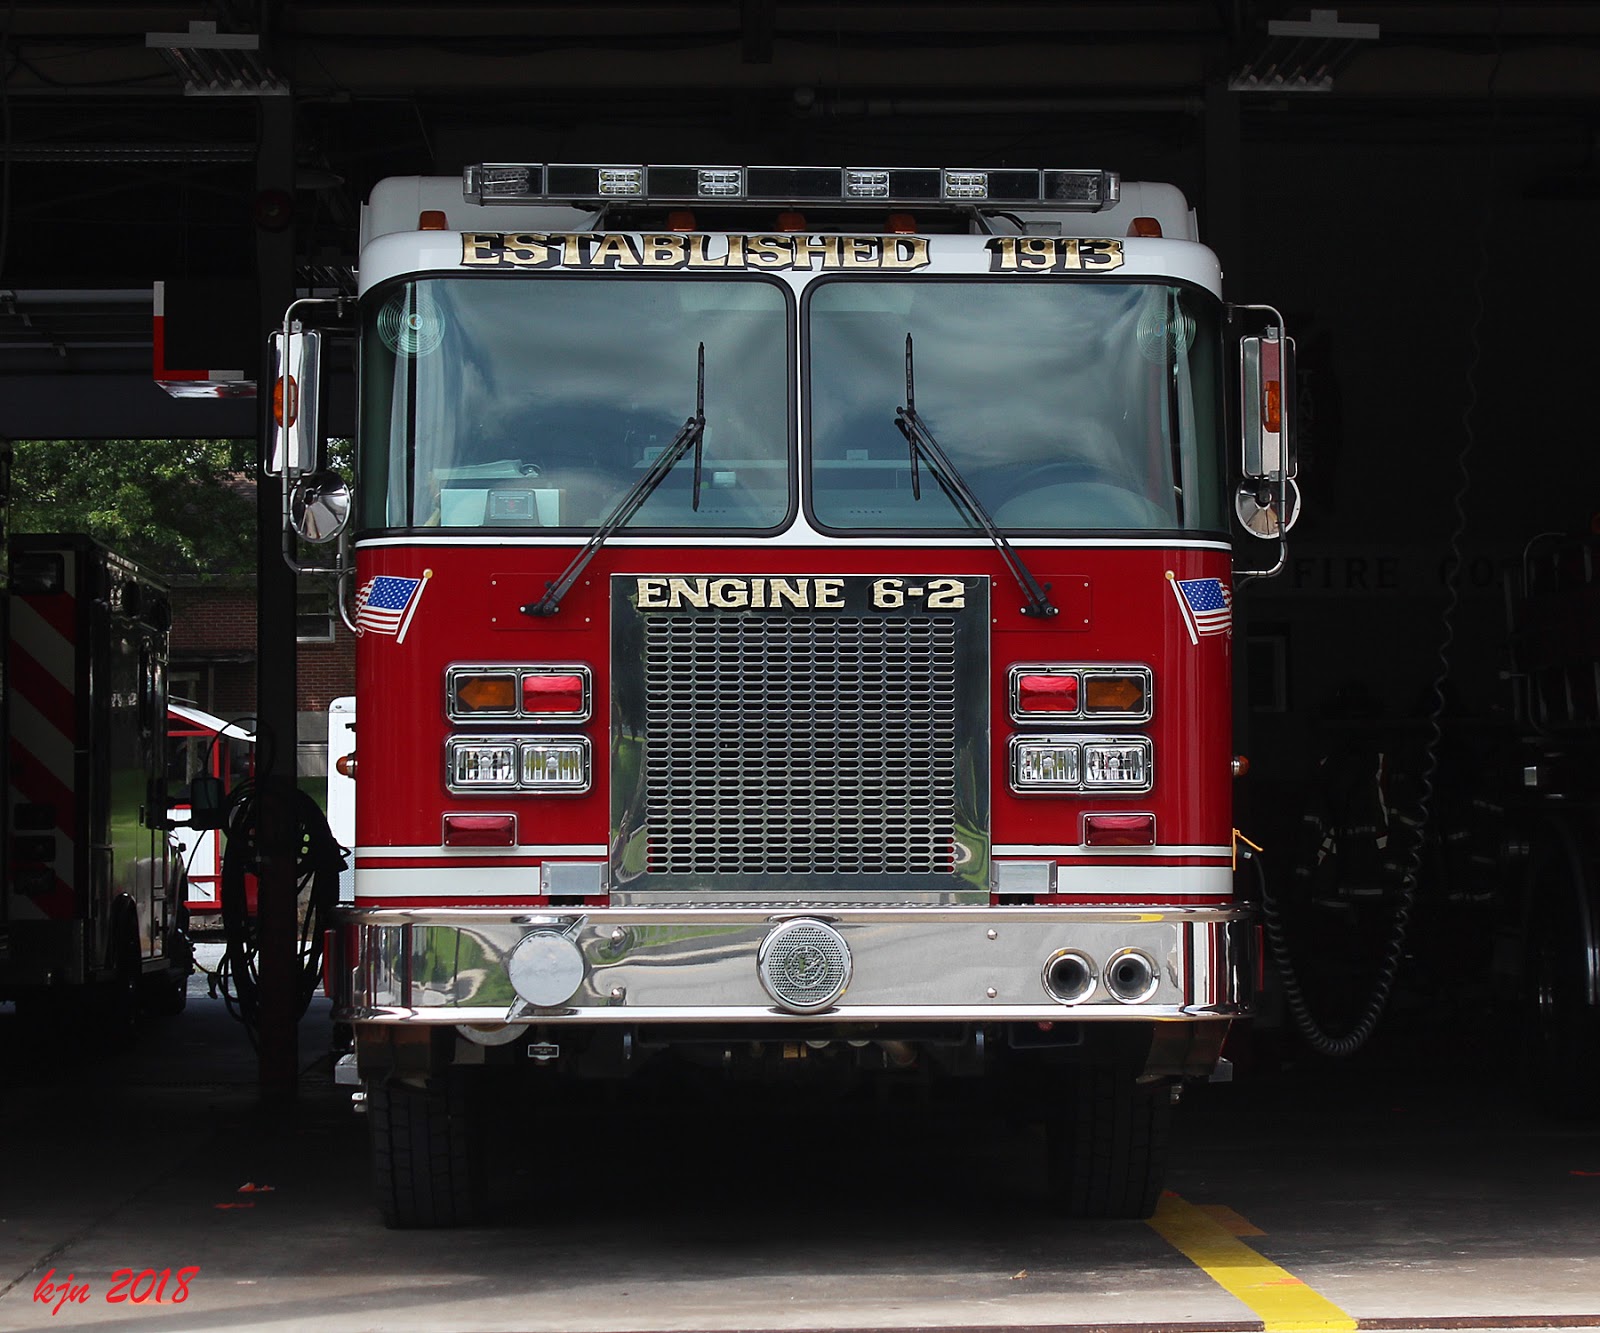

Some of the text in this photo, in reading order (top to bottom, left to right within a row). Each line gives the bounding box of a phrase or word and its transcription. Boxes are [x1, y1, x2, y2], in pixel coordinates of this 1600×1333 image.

[460, 232, 1125, 272] ESTABLISHED 1913
[1292, 557, 1400, 589] FIRE
[636, 577, 966, 612] ENGINE 6-2
